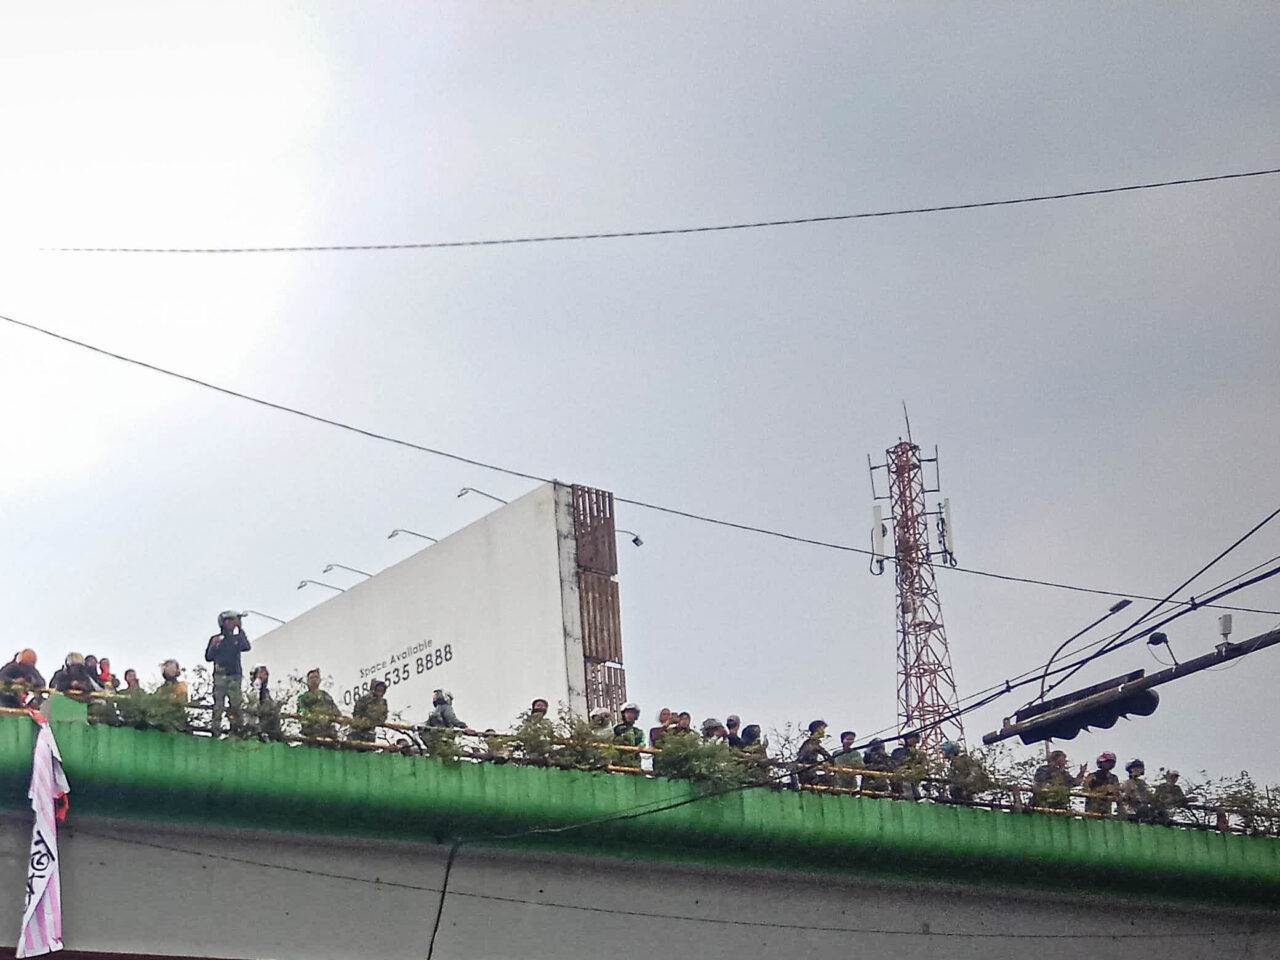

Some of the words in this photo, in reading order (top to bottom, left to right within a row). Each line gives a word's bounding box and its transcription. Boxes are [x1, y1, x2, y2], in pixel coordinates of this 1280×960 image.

[343, 678, 376, 706] 088
[384, 663, 410, 688] 535
[416, 644, 453, 675] 8888
[360, 660, 388, 679] Space
[390, 639, 433, 664] Available
